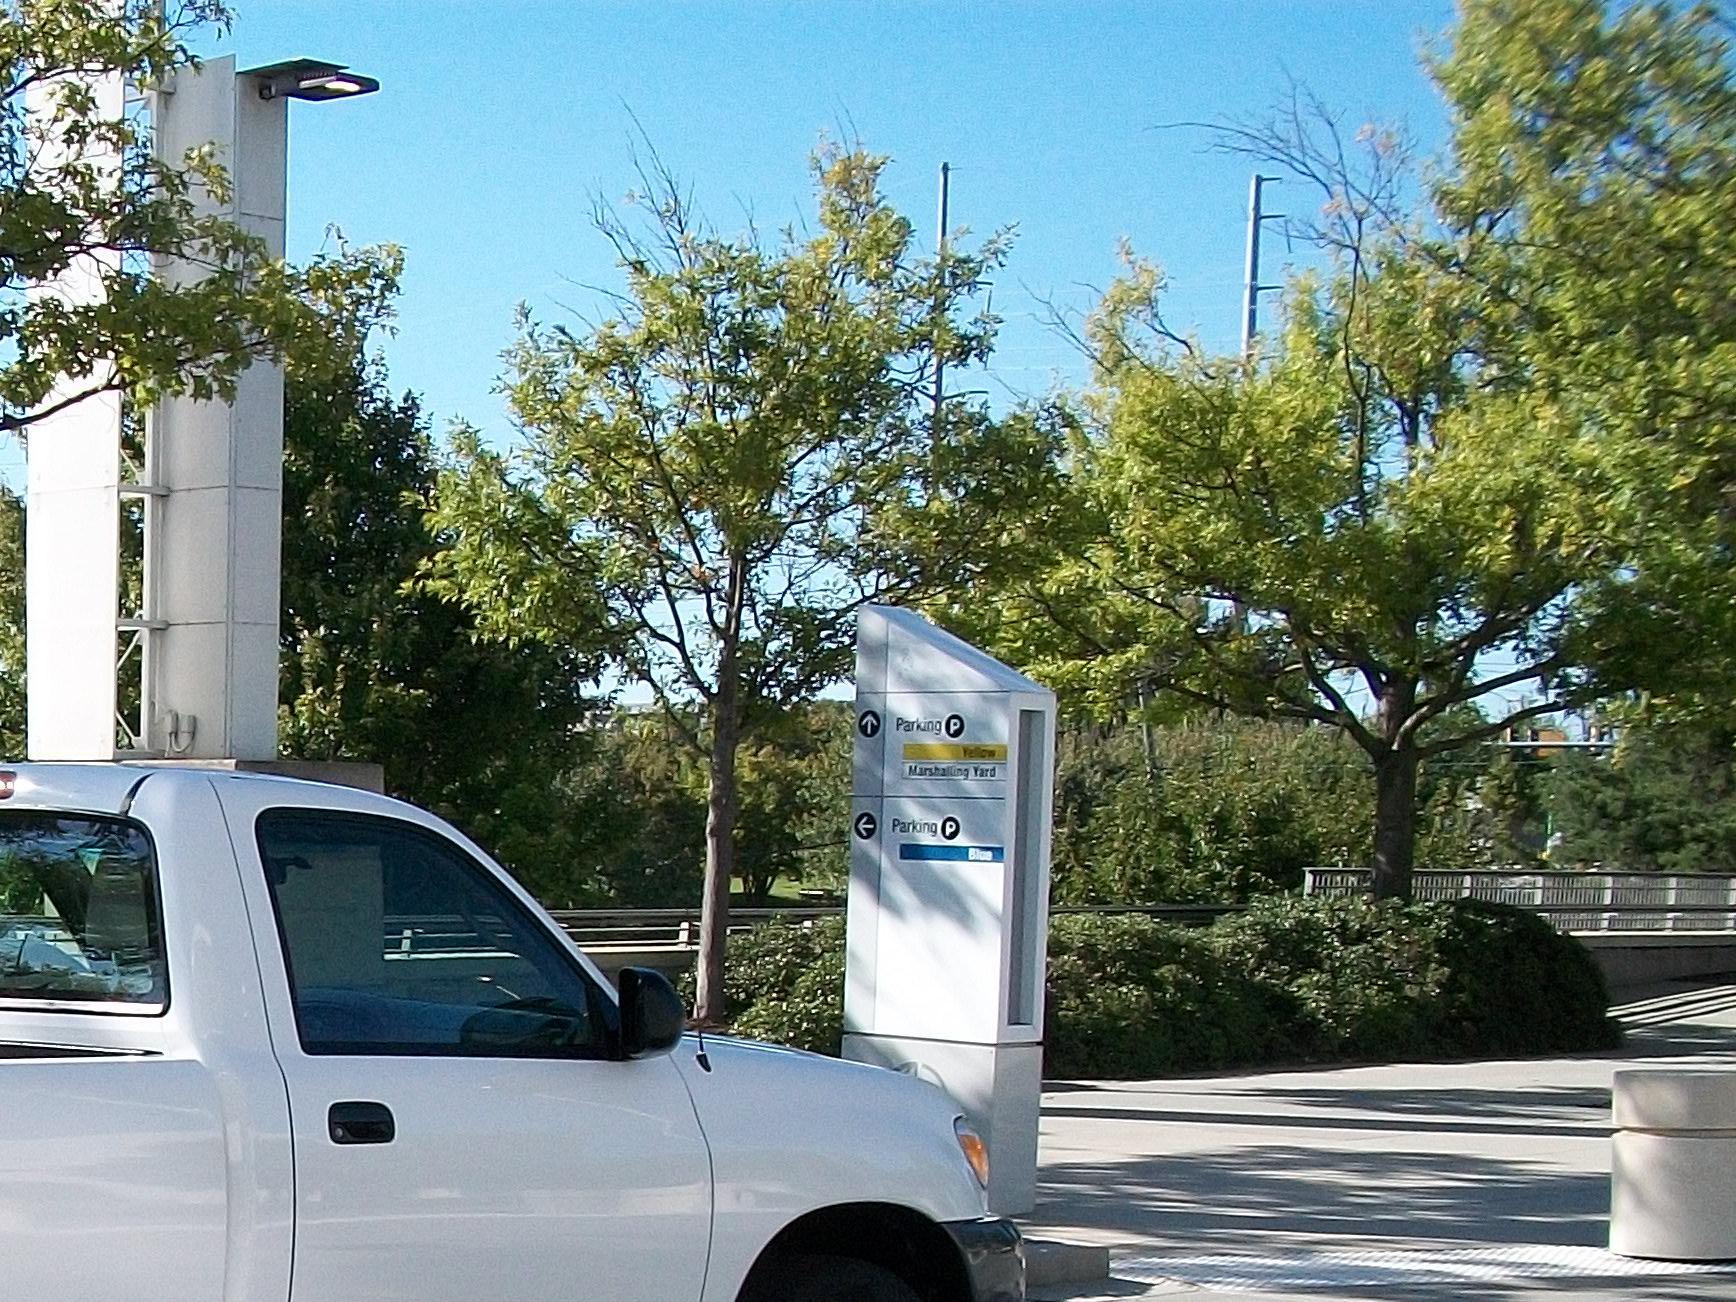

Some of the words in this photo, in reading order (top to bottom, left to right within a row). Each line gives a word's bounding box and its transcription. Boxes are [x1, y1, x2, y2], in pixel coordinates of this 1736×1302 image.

[896, 717, 942, 736] Parking
[963, 745, 996, 759] Yellow
[908, 766, 969, 780] Marshalling
[973, 766, 996, 778] Yard
[892, 818, 938, 837] Parking
